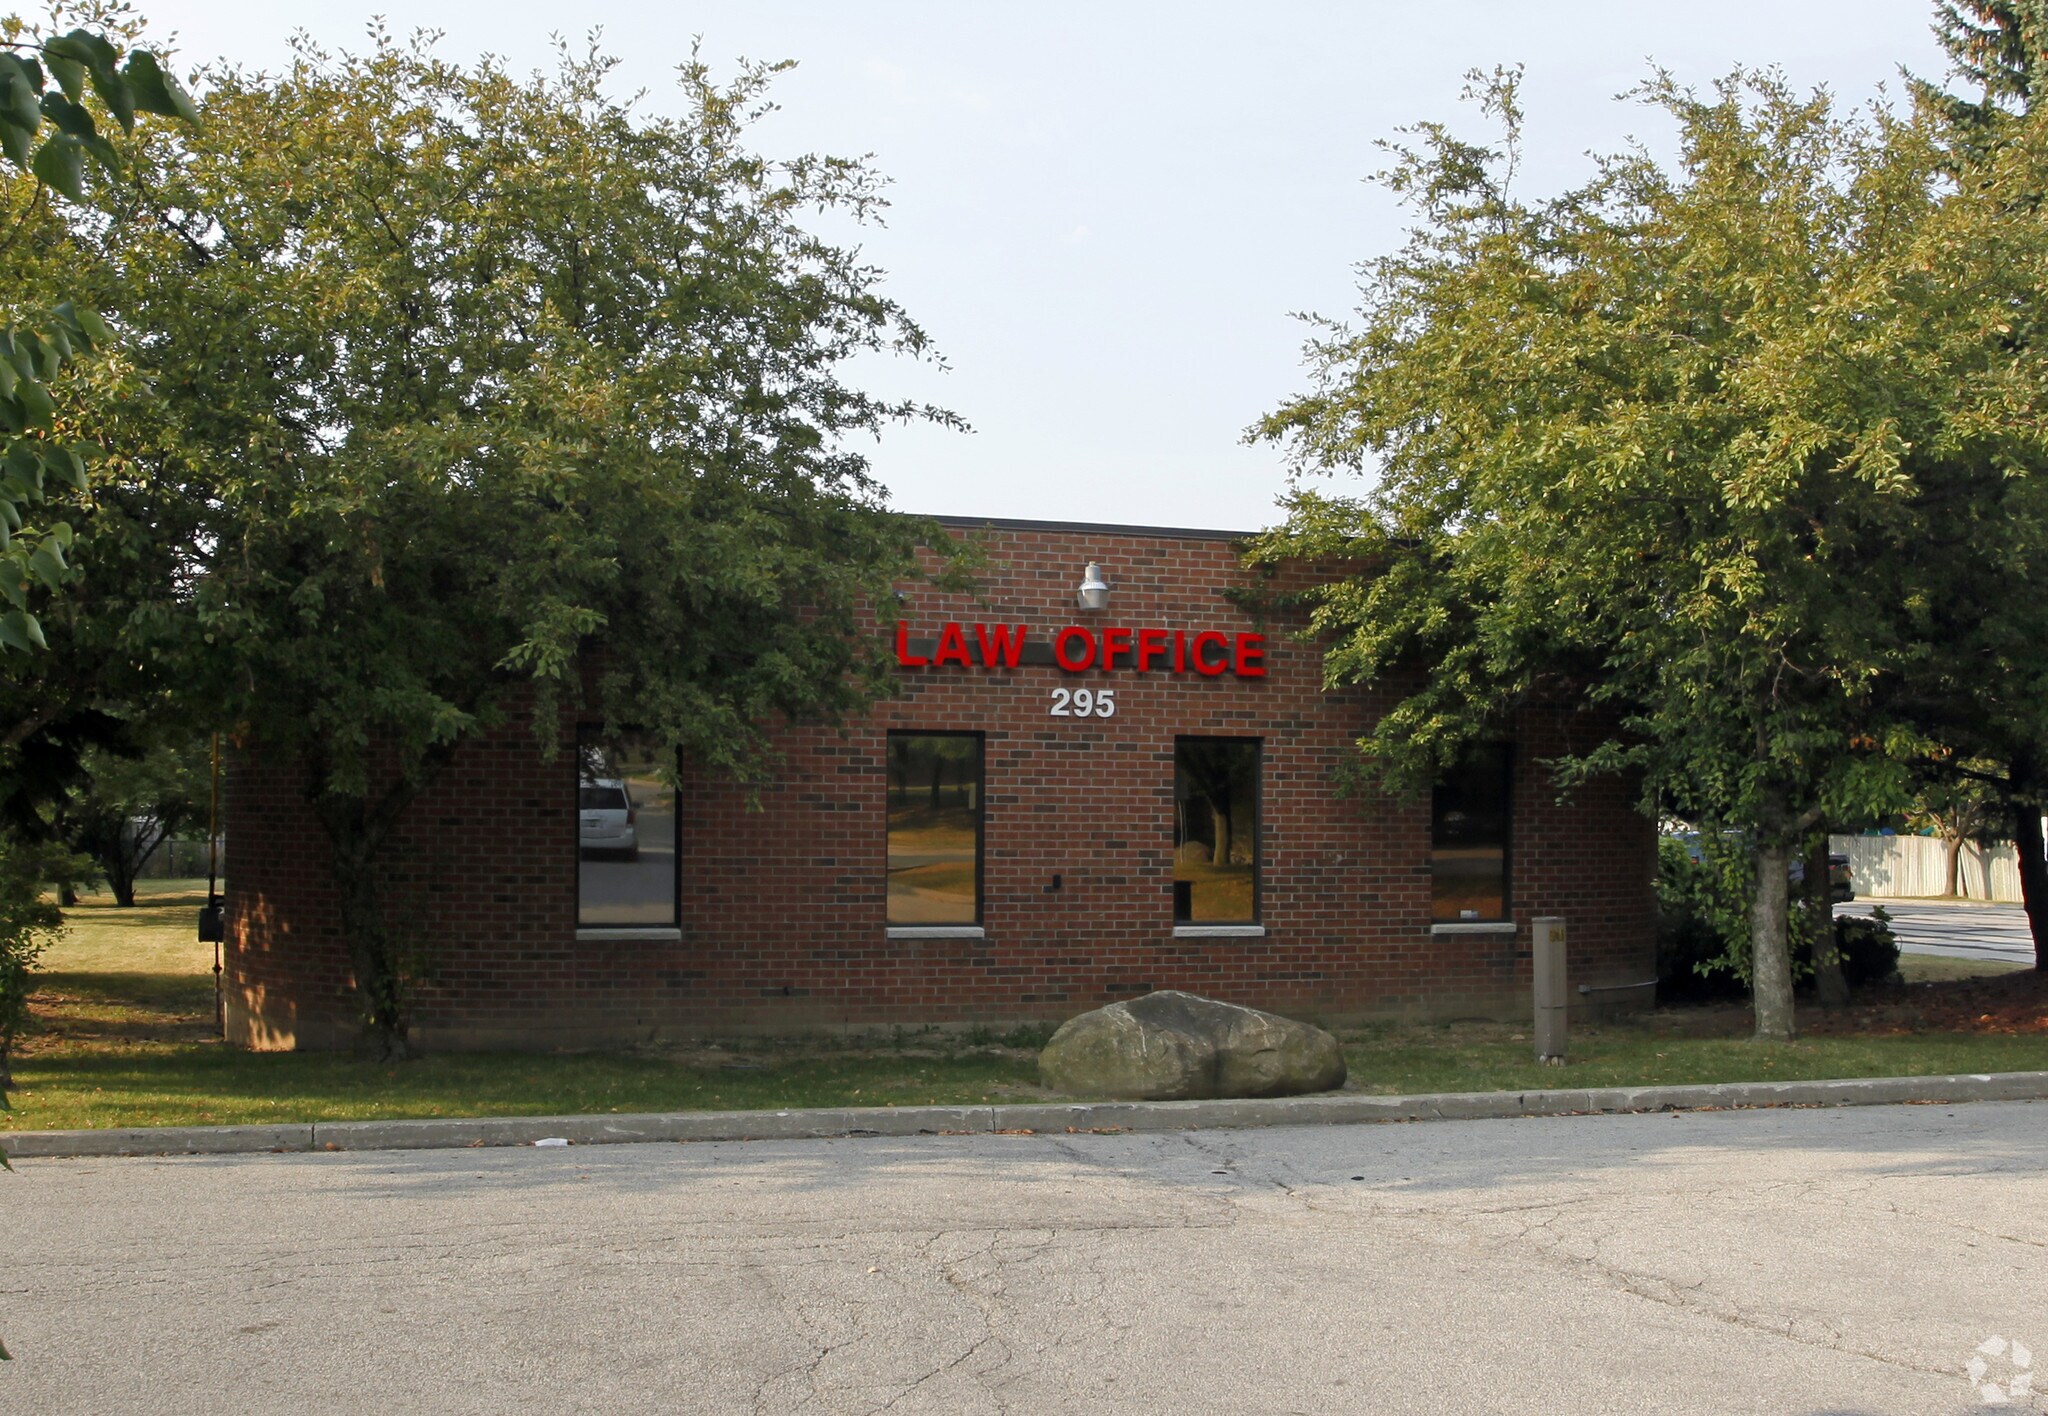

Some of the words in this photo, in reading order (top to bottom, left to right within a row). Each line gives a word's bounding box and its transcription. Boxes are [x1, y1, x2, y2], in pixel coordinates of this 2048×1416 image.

[896, 620, 1028, 669] LAW
[1054, 626, 1266, 677] OFFICE
[1050, 688, 1115, 718] 295
